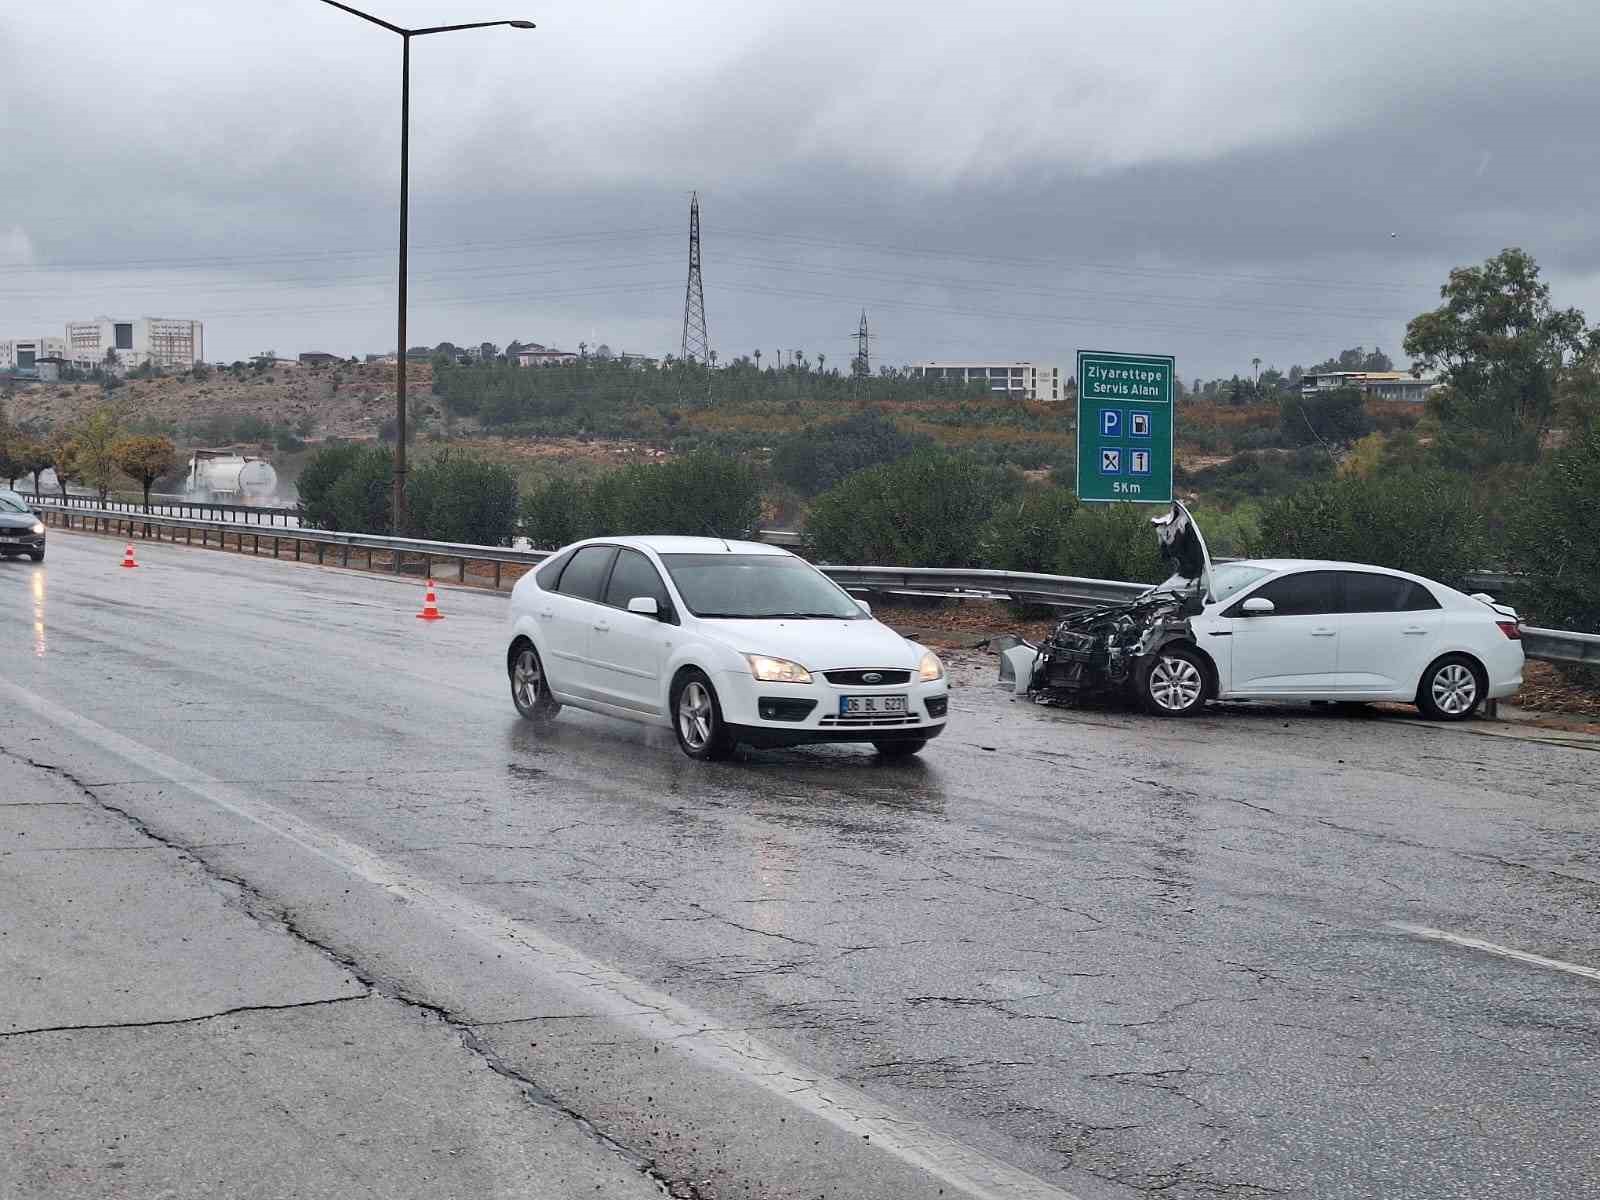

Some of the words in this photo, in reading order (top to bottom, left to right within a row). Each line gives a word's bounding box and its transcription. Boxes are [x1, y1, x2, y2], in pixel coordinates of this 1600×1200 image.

[1088, 366, 1162, 383] Ziyarettepe
[1094, 382, 1128, 394] Servis
[1131, 384, 1159, 396] Alanı
[1104, 412, 1118, 434] P
